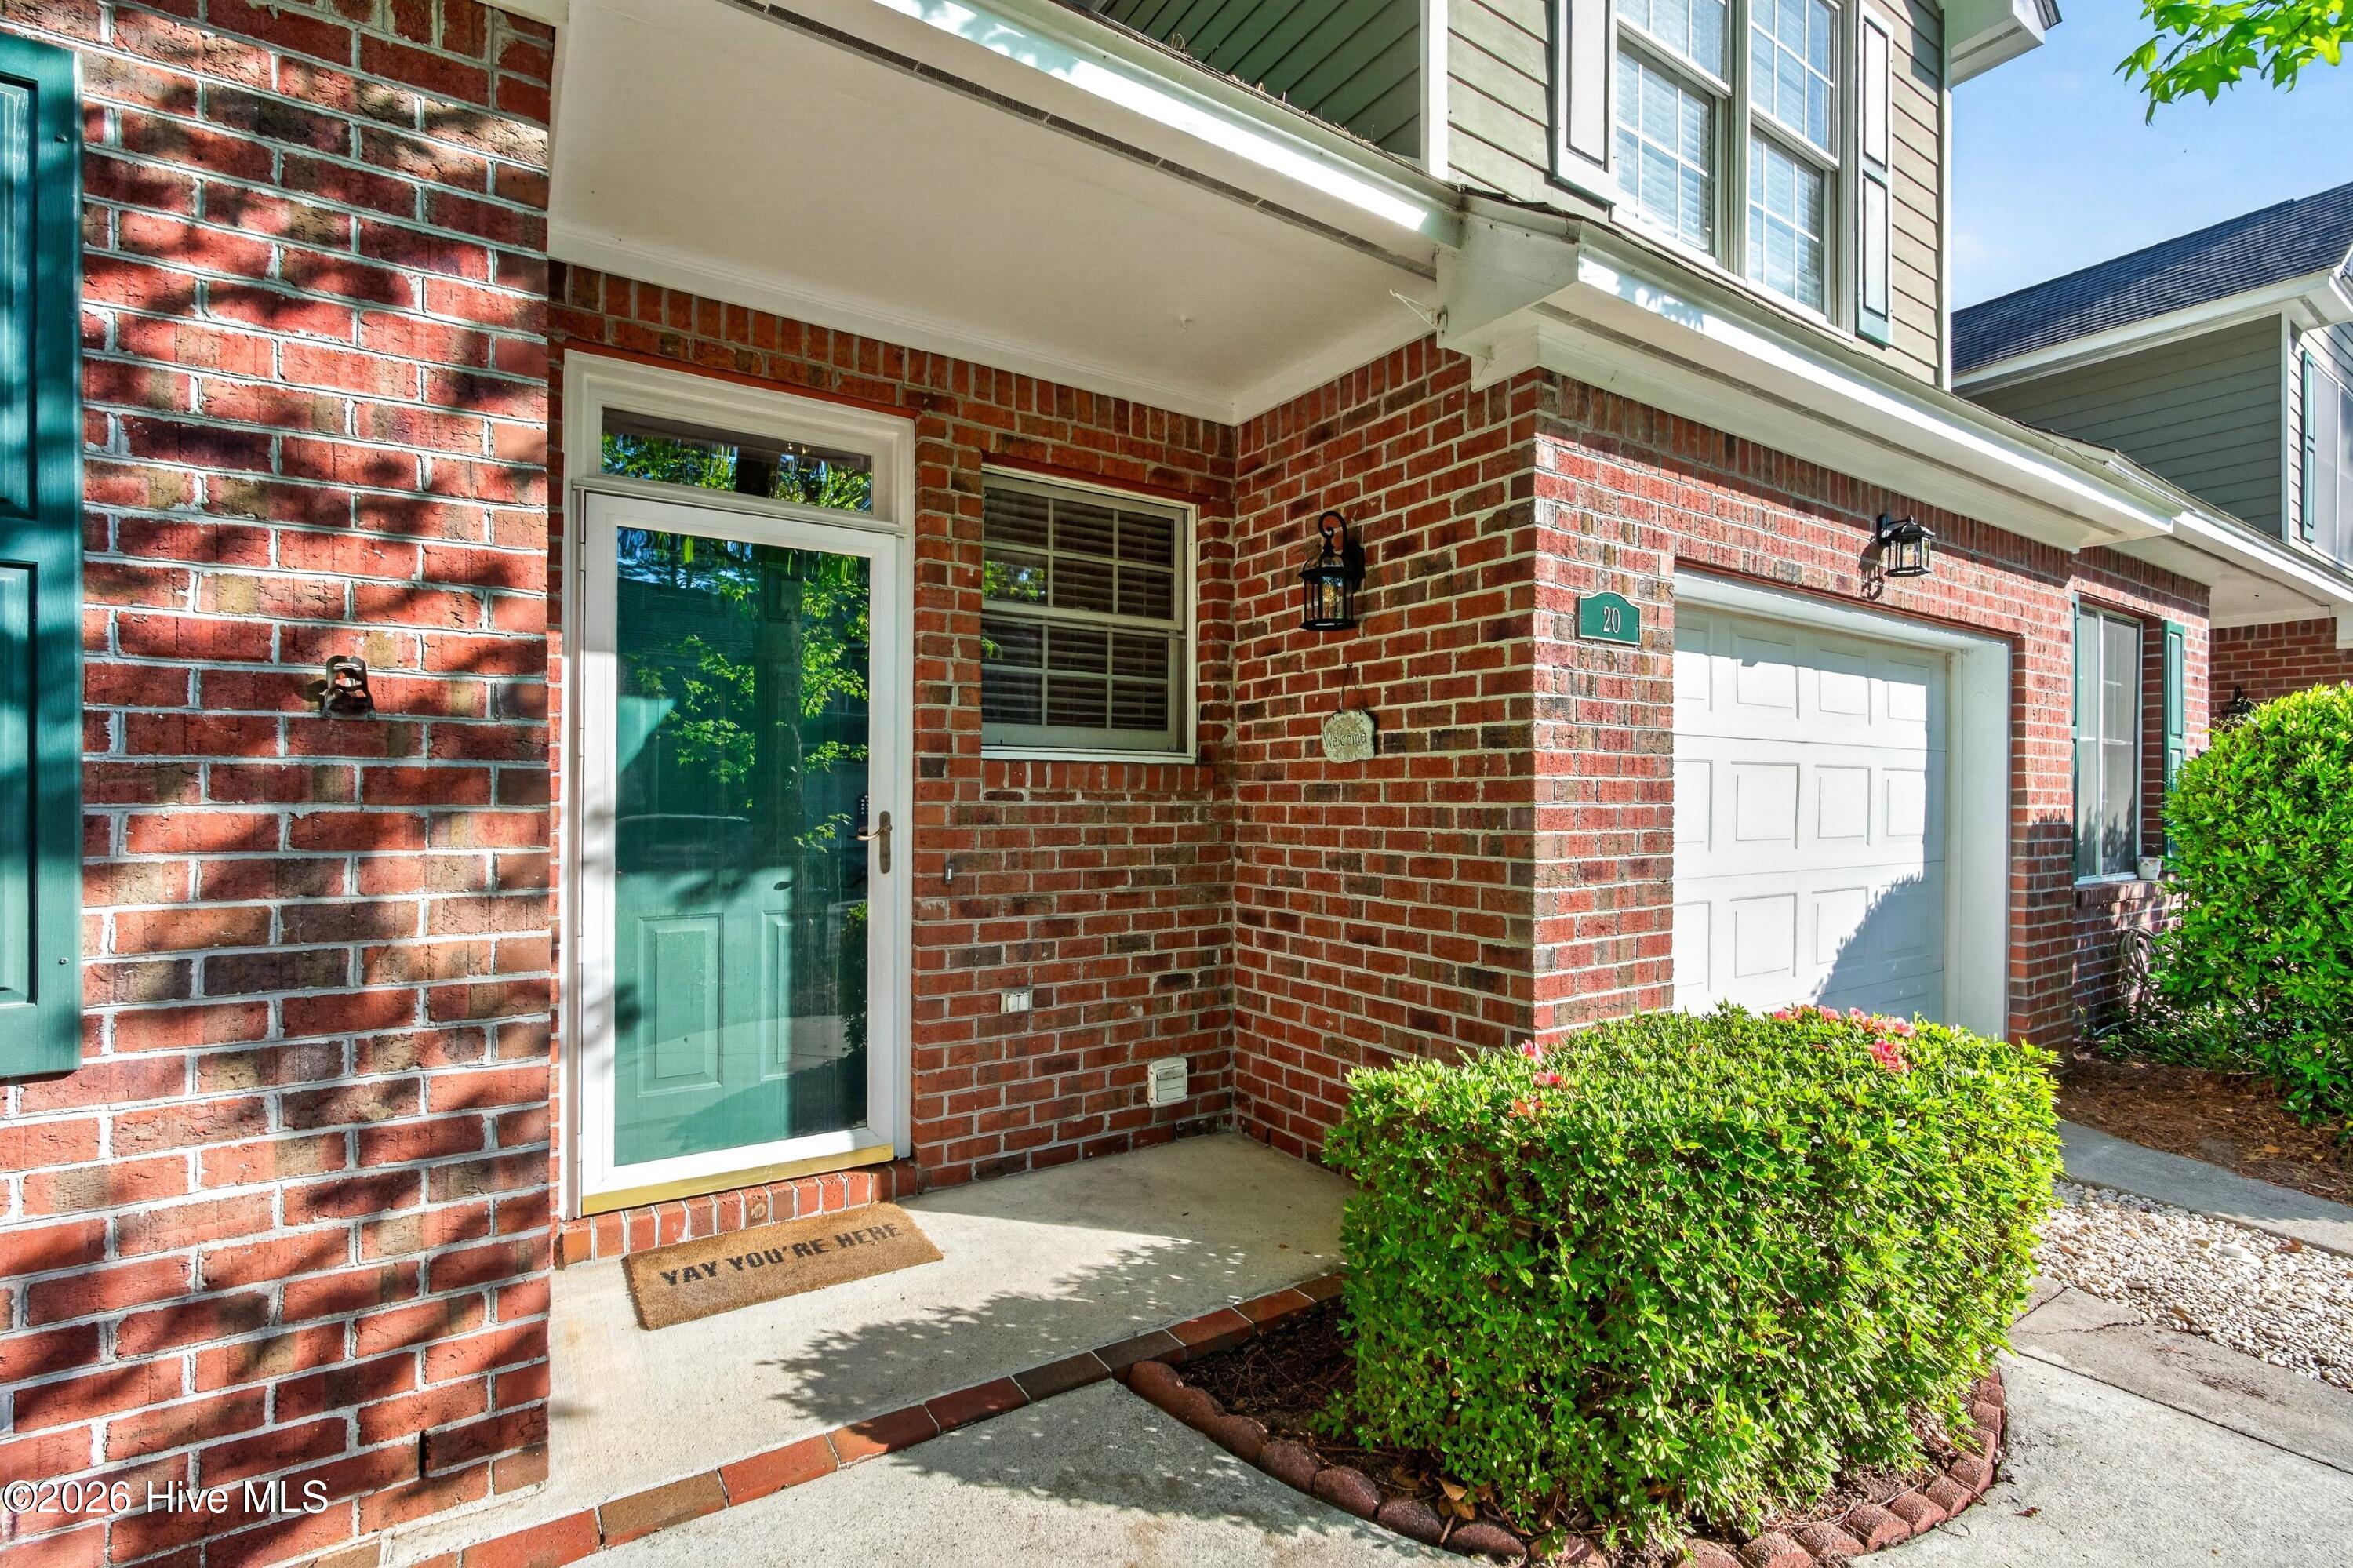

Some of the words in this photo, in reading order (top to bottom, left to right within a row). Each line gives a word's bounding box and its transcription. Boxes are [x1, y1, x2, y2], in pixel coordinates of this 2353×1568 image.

[1603, 606, 1620, 633] 20
[660, 1260, 718, 1286] YAY
[728, 1238, 830, 1271] YOU'RE
[835, 1222, 902, 1247] HERE
